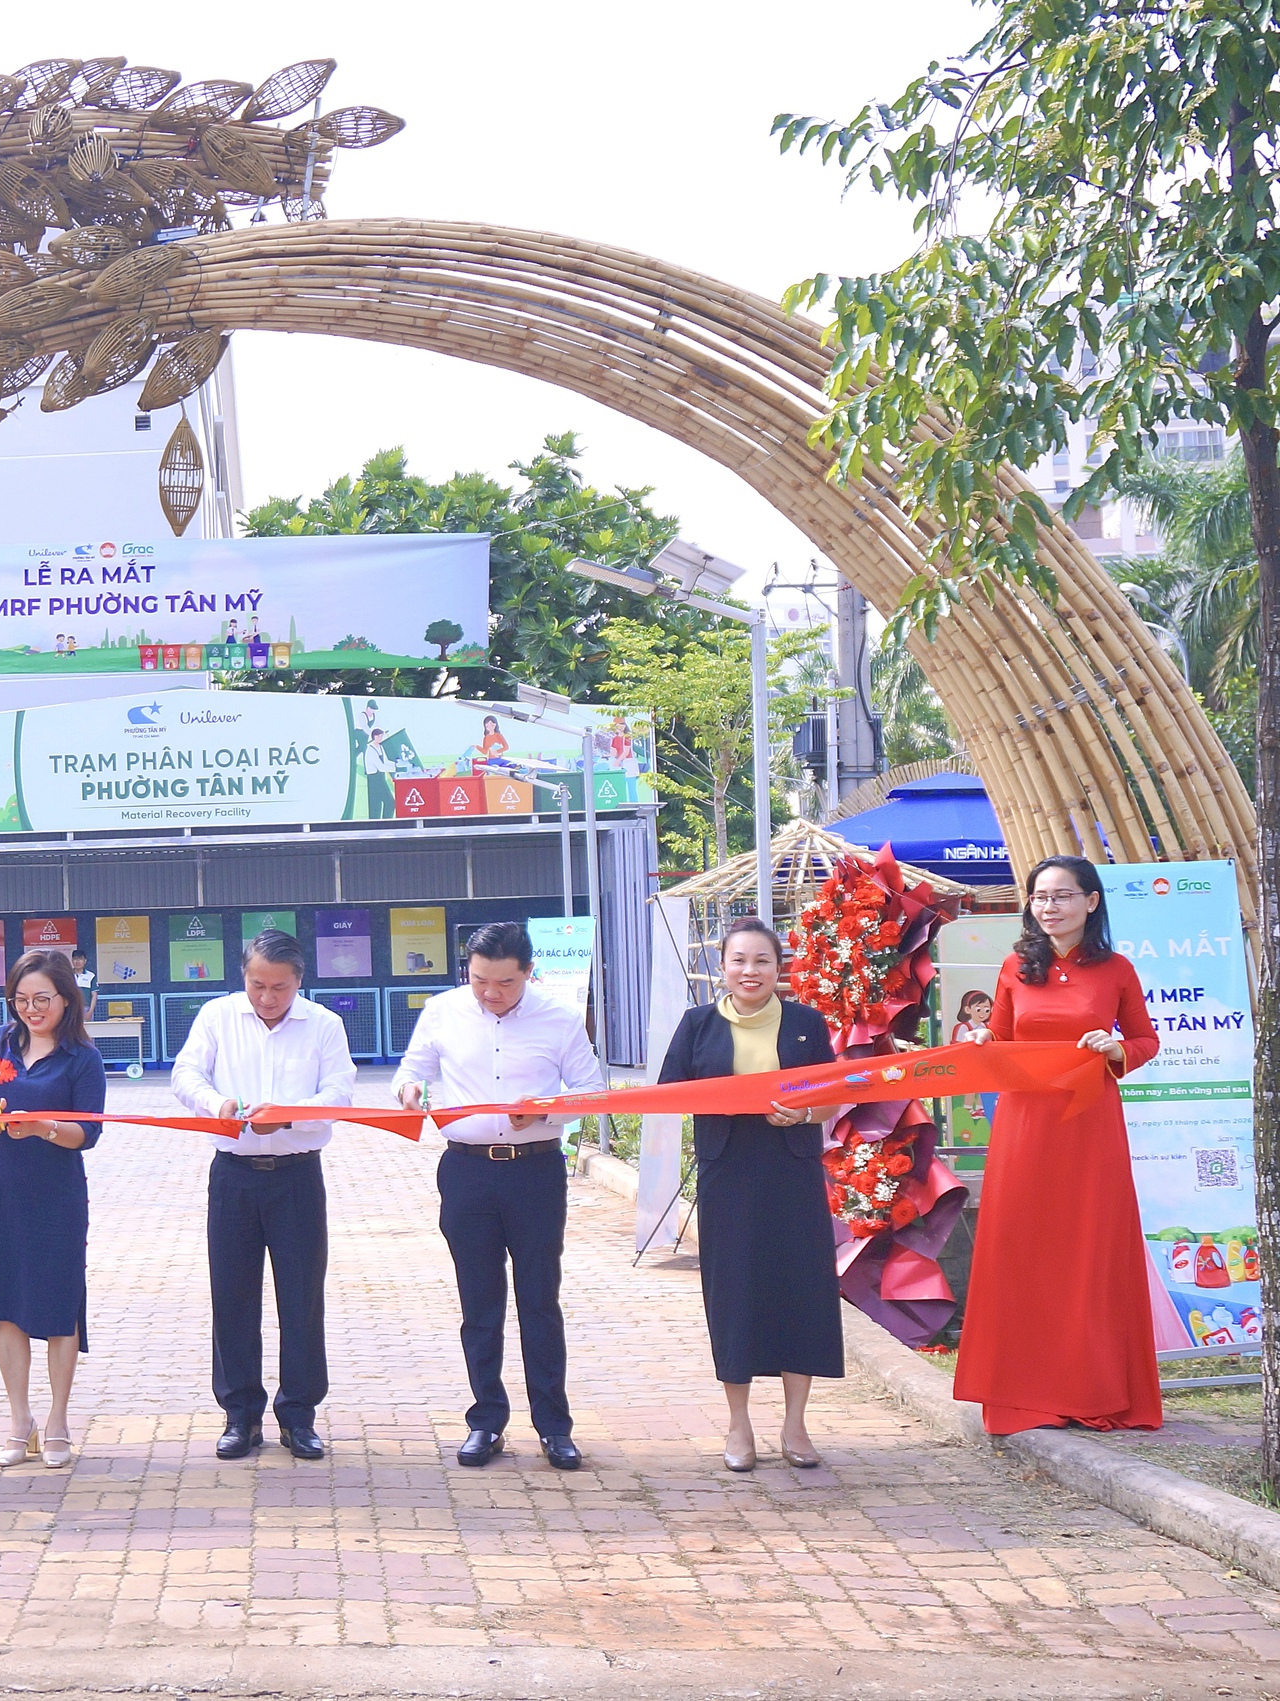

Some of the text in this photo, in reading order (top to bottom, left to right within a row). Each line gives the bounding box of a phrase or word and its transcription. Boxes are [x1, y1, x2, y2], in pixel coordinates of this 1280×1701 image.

[28, 548, 67, 557] Unilever
[122, 543, 154, 555] Grac
[24, 558, 156, 586] LỄ RA MẮT
[49, 592, 158, 616] PHƯỜNG
[165, 590, 216, 613] TÂN
[225, 588, 264, 612] MỸ
[180, 710, 242, 724] Unilever
[124, 726, 147, 734] PHƯỜNG
[148, 725, 158, 733] TÂN
[49, 741, 321, 778] TRẠM PHÂN LOẠI RÁC
[81, 770, 290, 801] PHƯỜNG TÂN MỸ
[604, 787, 610, 795] 5
[506, 792, 513, 801] 3
[121, 806, 251, 822] Material Recovery Facility
[945, 843, 988, 860] NGÂN
[1177, 879, 1212, 890] Grac
[1117, 929, 1232, 959] RA MẮT
[546, 948, 561, 957] RÁC
[563, 946, 577, 957] LẤY
[1161, 987, 1205, 1003] MRF
[1164, 1013, 1207, 1031] TÂN
[1214, 1011, 1245, 1030] MỸ
[1164, 1045, 1203, 1055] thu hồi
[1148, 1055, 1220, 1066] và rác tái chế
[913, 1061, 956, 1077] Grac
[1124, 1087, 1144, 1096] hôm
[1146, 1089, 1162, 1097] nay
[1169, 1086, 1187, 1095] Bền
[1189, 1086, 1212, 1096] vững
[1175, 1119, 1198, 1127] tháng
